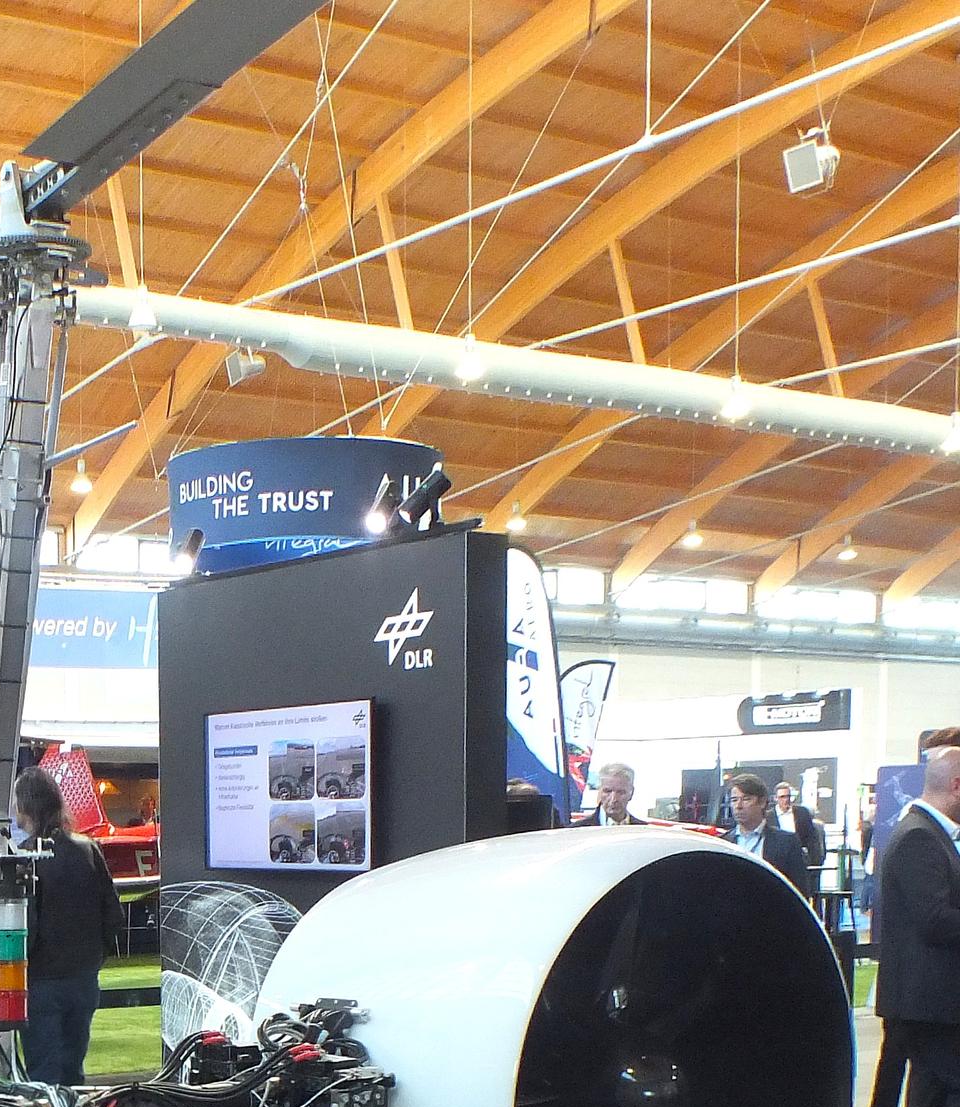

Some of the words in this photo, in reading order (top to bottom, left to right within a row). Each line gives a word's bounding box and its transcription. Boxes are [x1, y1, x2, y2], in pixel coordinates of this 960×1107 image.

[179, 472, 254, 504] BUILDING
[212, 495, 249, 520] THE
[258, 491, 334, 514] TRUST
[32, 615, 88, 637] wered
[93, 616, 118, 642] by
[404, 648, 433, 670] DLR
